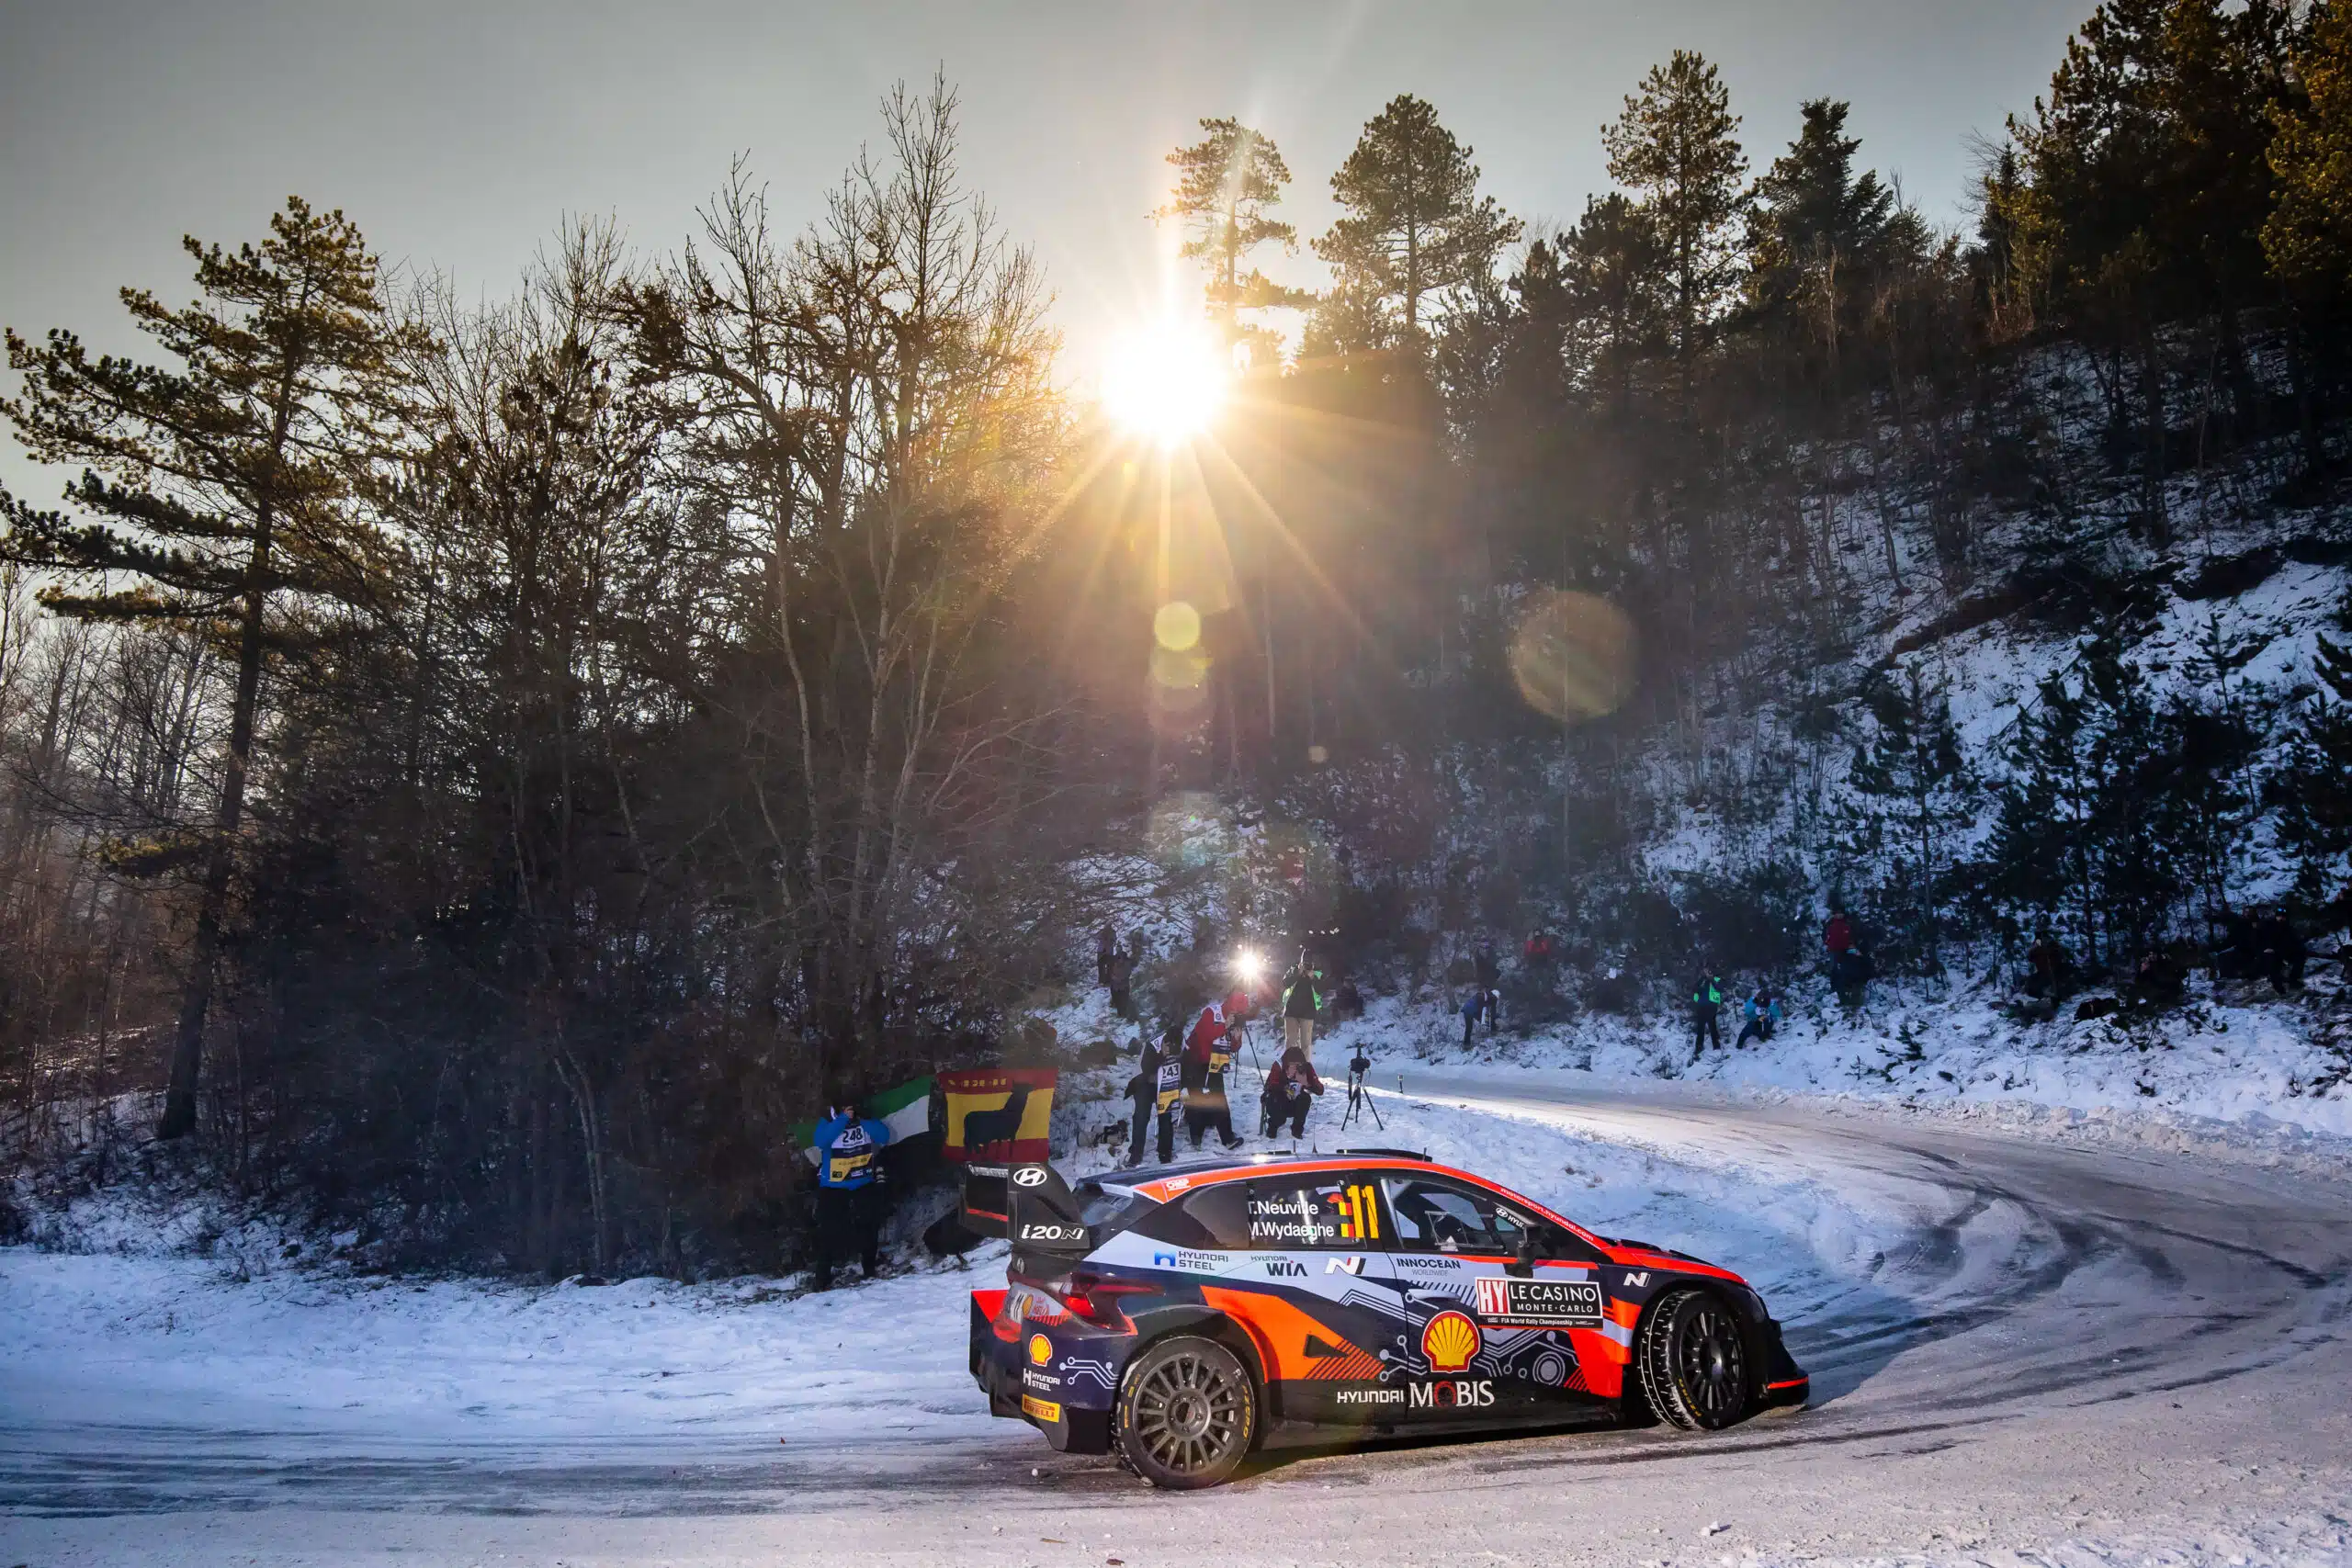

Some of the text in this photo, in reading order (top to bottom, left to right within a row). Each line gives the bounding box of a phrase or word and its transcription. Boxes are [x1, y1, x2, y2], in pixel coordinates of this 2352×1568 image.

[842, 1128, 863, 1143] 248
[1347, 1185, 1379, 1238] 11
[1179, 1251, 1228, 1262] HYUNDAI
[1396, 1258, 1461, 1269] INNOCEAN
[1179, 1260, 1216, 1270] STEEL
[1266, 1260, 1308, 1276] WIA
[1477, 1280, 1506, 1313] HY
[1510, 1284, 1597, 1302] LE CASINO
[1032, 1372, 1060, 1385] HYUNDAI
[1032, 1380, 1051, 1391] STEEL
[1337, 1381, 1495, 1408] HYUNDAI MOBIS
[1023, 1398, 1056, 1418] PIRELLI
